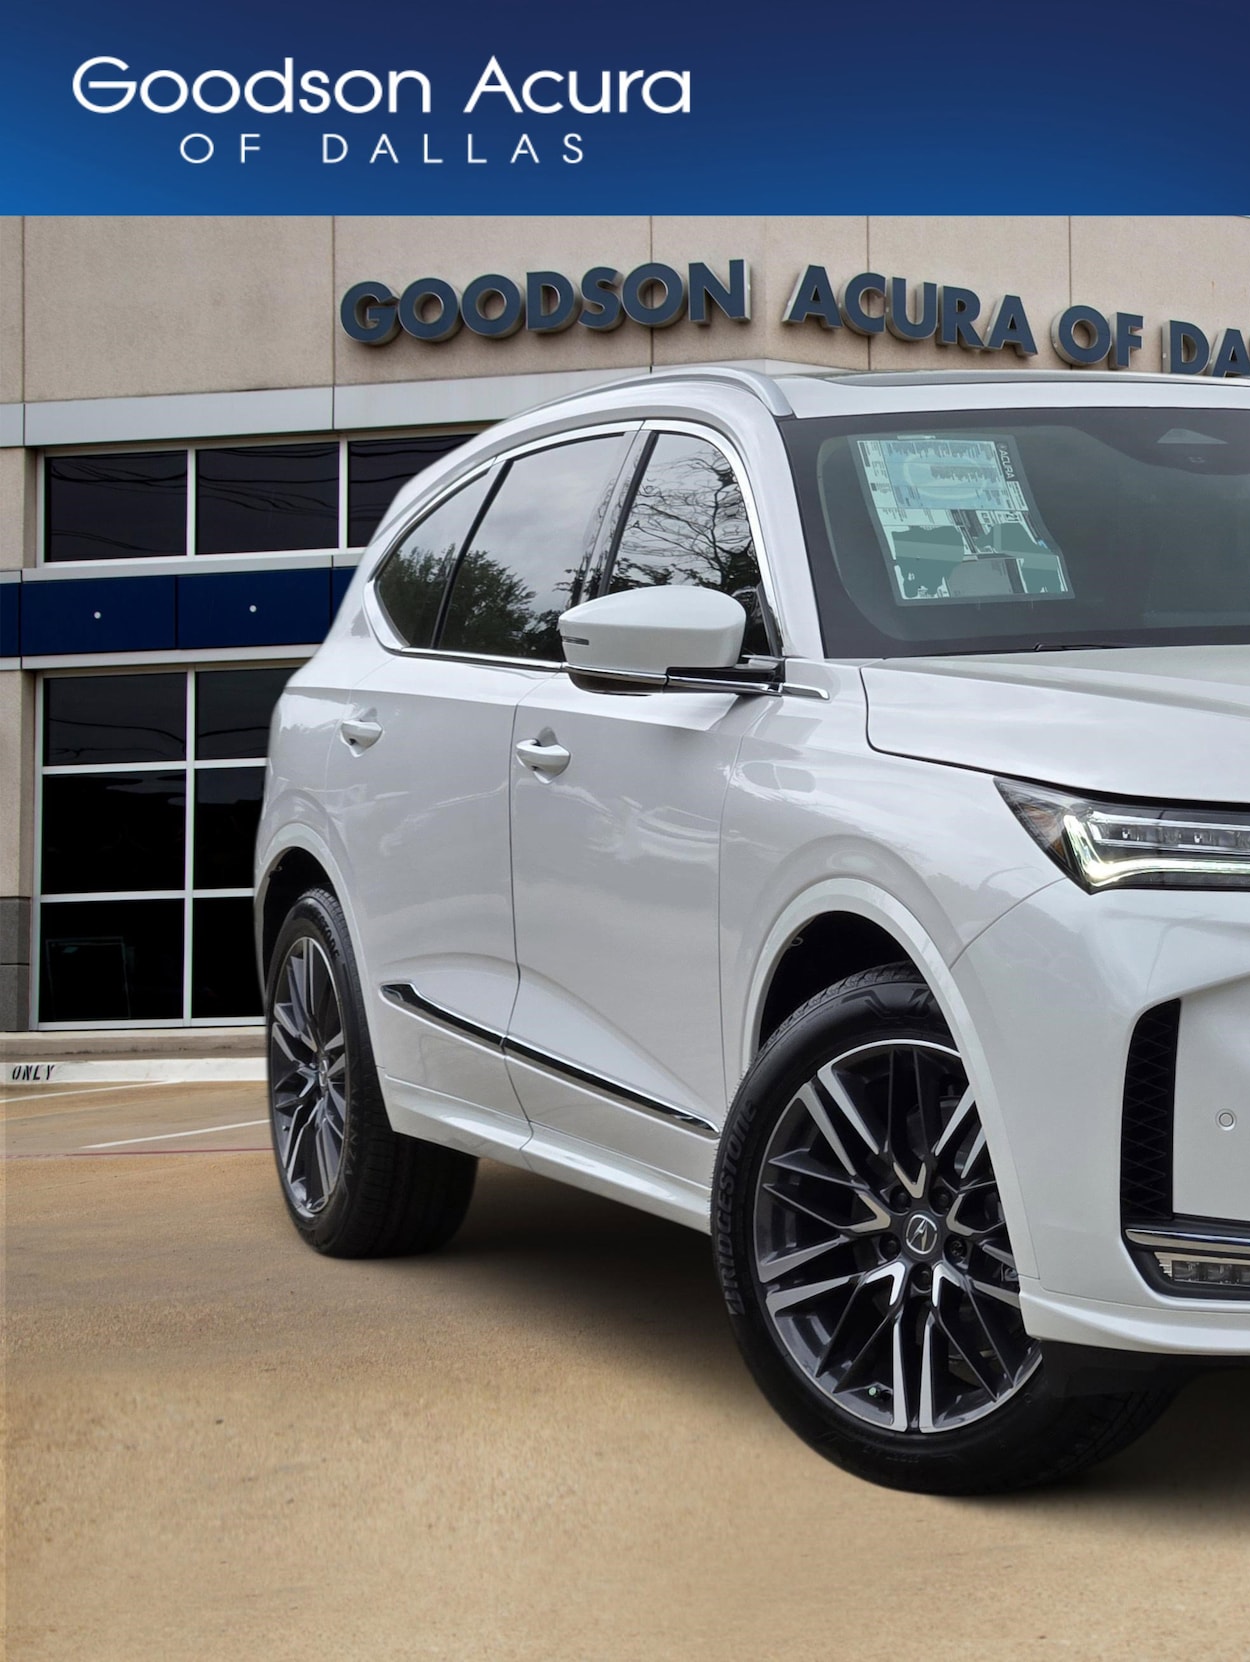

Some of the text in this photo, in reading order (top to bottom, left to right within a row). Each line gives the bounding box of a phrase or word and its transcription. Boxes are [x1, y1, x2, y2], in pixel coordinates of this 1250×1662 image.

[340, 258, 751, 345] GOODSON
[782, 264, 1039, 357] ACURA
[1051, 305, 1144, 370] OF
[999, 448, 1016, 481] ACURA
[11, 1064, 55, 1081] ONLY
[716, 1098, 758, 1316] BRIDGESTONE
